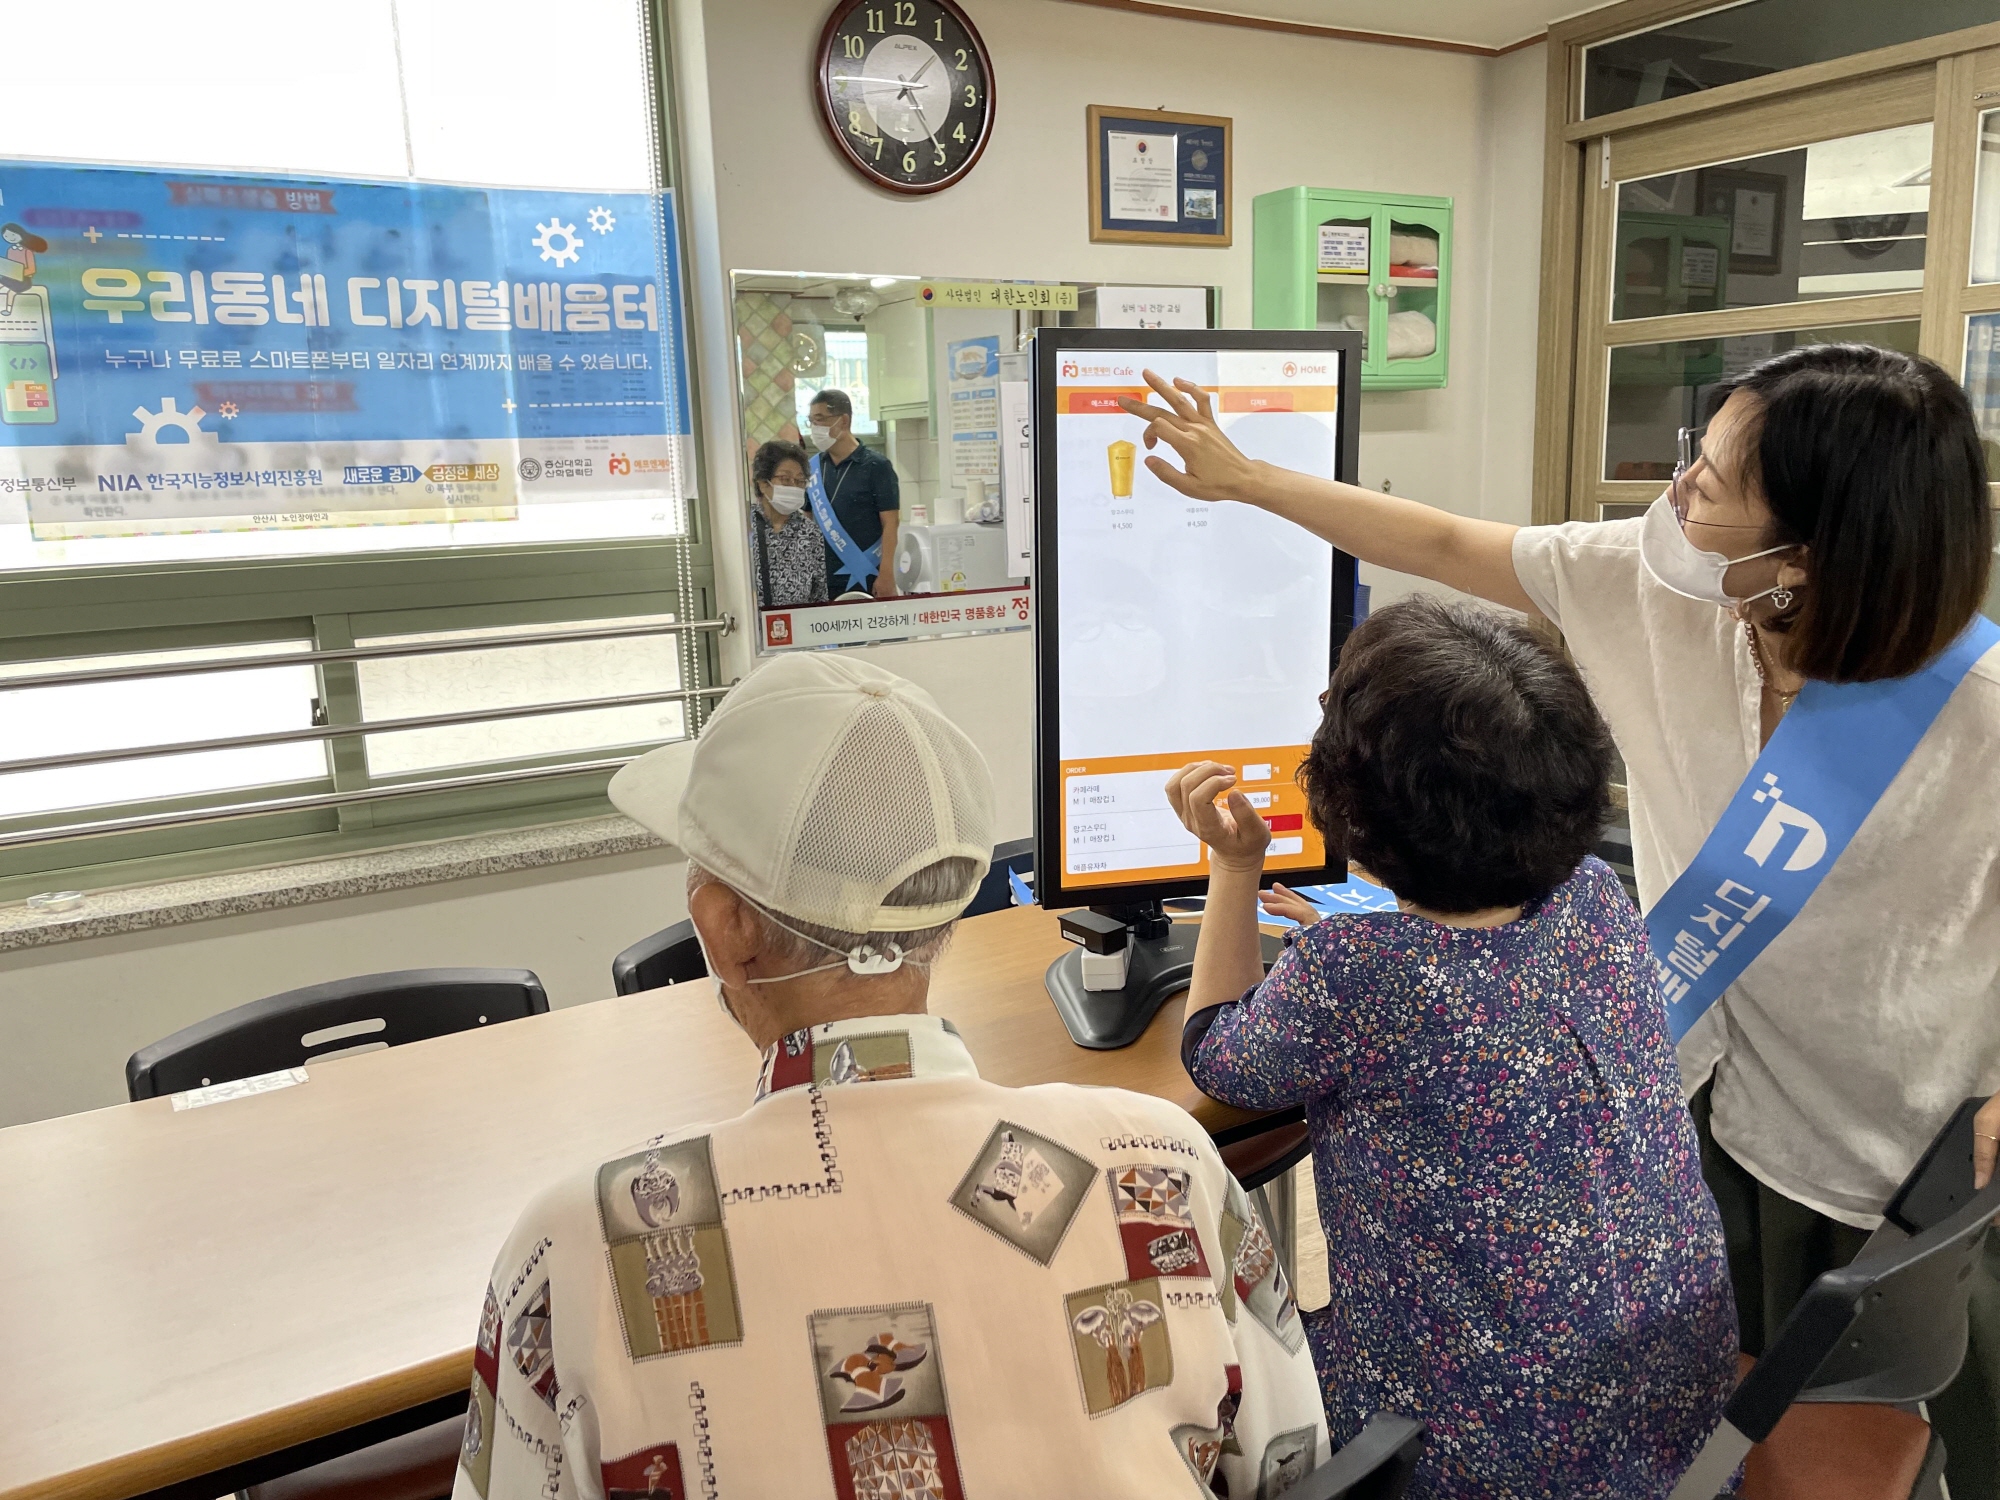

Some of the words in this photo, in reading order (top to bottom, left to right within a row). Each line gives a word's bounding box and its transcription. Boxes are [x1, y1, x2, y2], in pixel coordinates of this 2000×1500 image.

[866, 9, 886, 33] 11
[894, 2, 917, 26] 12
[934, 18, 943, 41] 1
[842, 35, 865, 58] 10
[955, 49, 968, 71] 2
[835, 68, 848, 94] 9
[964, 85, 976, 108] 3
[848, 111, 861, 135] 8
[952, 122, 966, 144] 4
[872, 138, 883, 160] 7
[934, 143, 946, 166] 5
[903, 150, 916, 173] 6
[81, 268, 330, 327] 우리동네
[347, 276, 659, 332] 디지털배움터
[945, 289, 981, 302] 사단법인
[990, 288, 1050, 306] 대한노인회
[1167, 304, 1181, 313] 교실
[105, 350, 172, 369] 누구나
[179, 350, 243, 369] 무료로
[250, 351, 370, 370] 스마트폰부터
[377, 351, 434, 371] 일자리
[440, 352, 513, 372] 연계까지
[518, 353, 553, 371] 배울
[558, 354, 576, 372] 수
[580, 353, 653, 371] 있습니다.
[1113, 366, 1134, 376] Cafe
[1300, 365, 1327, 374] HOME
[432, 465, 469, 482] 공정한
[474, 464, 498, 481] 세상
[544, 458, 593, 468] 총신대학교
[98, 474, 143, 491] NIA
[146, 469, 323, 491] 한국지능정보사회진흥원
[345, 466, 383, 483] 새로운
[389, 466, 415, 482] 경기
[252, 514, 277, 524] 안산시
[281, 512, 329, 523] 노인장애인과
[810, 618, 863, 634] 100세까지
[866, 614, 910, 630] 건강하게
[919, 609, 962, 625] 대한민국
[965, 604, 1006, 621] 명품홍삼
[1073, 862, 1107, 872] 애플유자차
